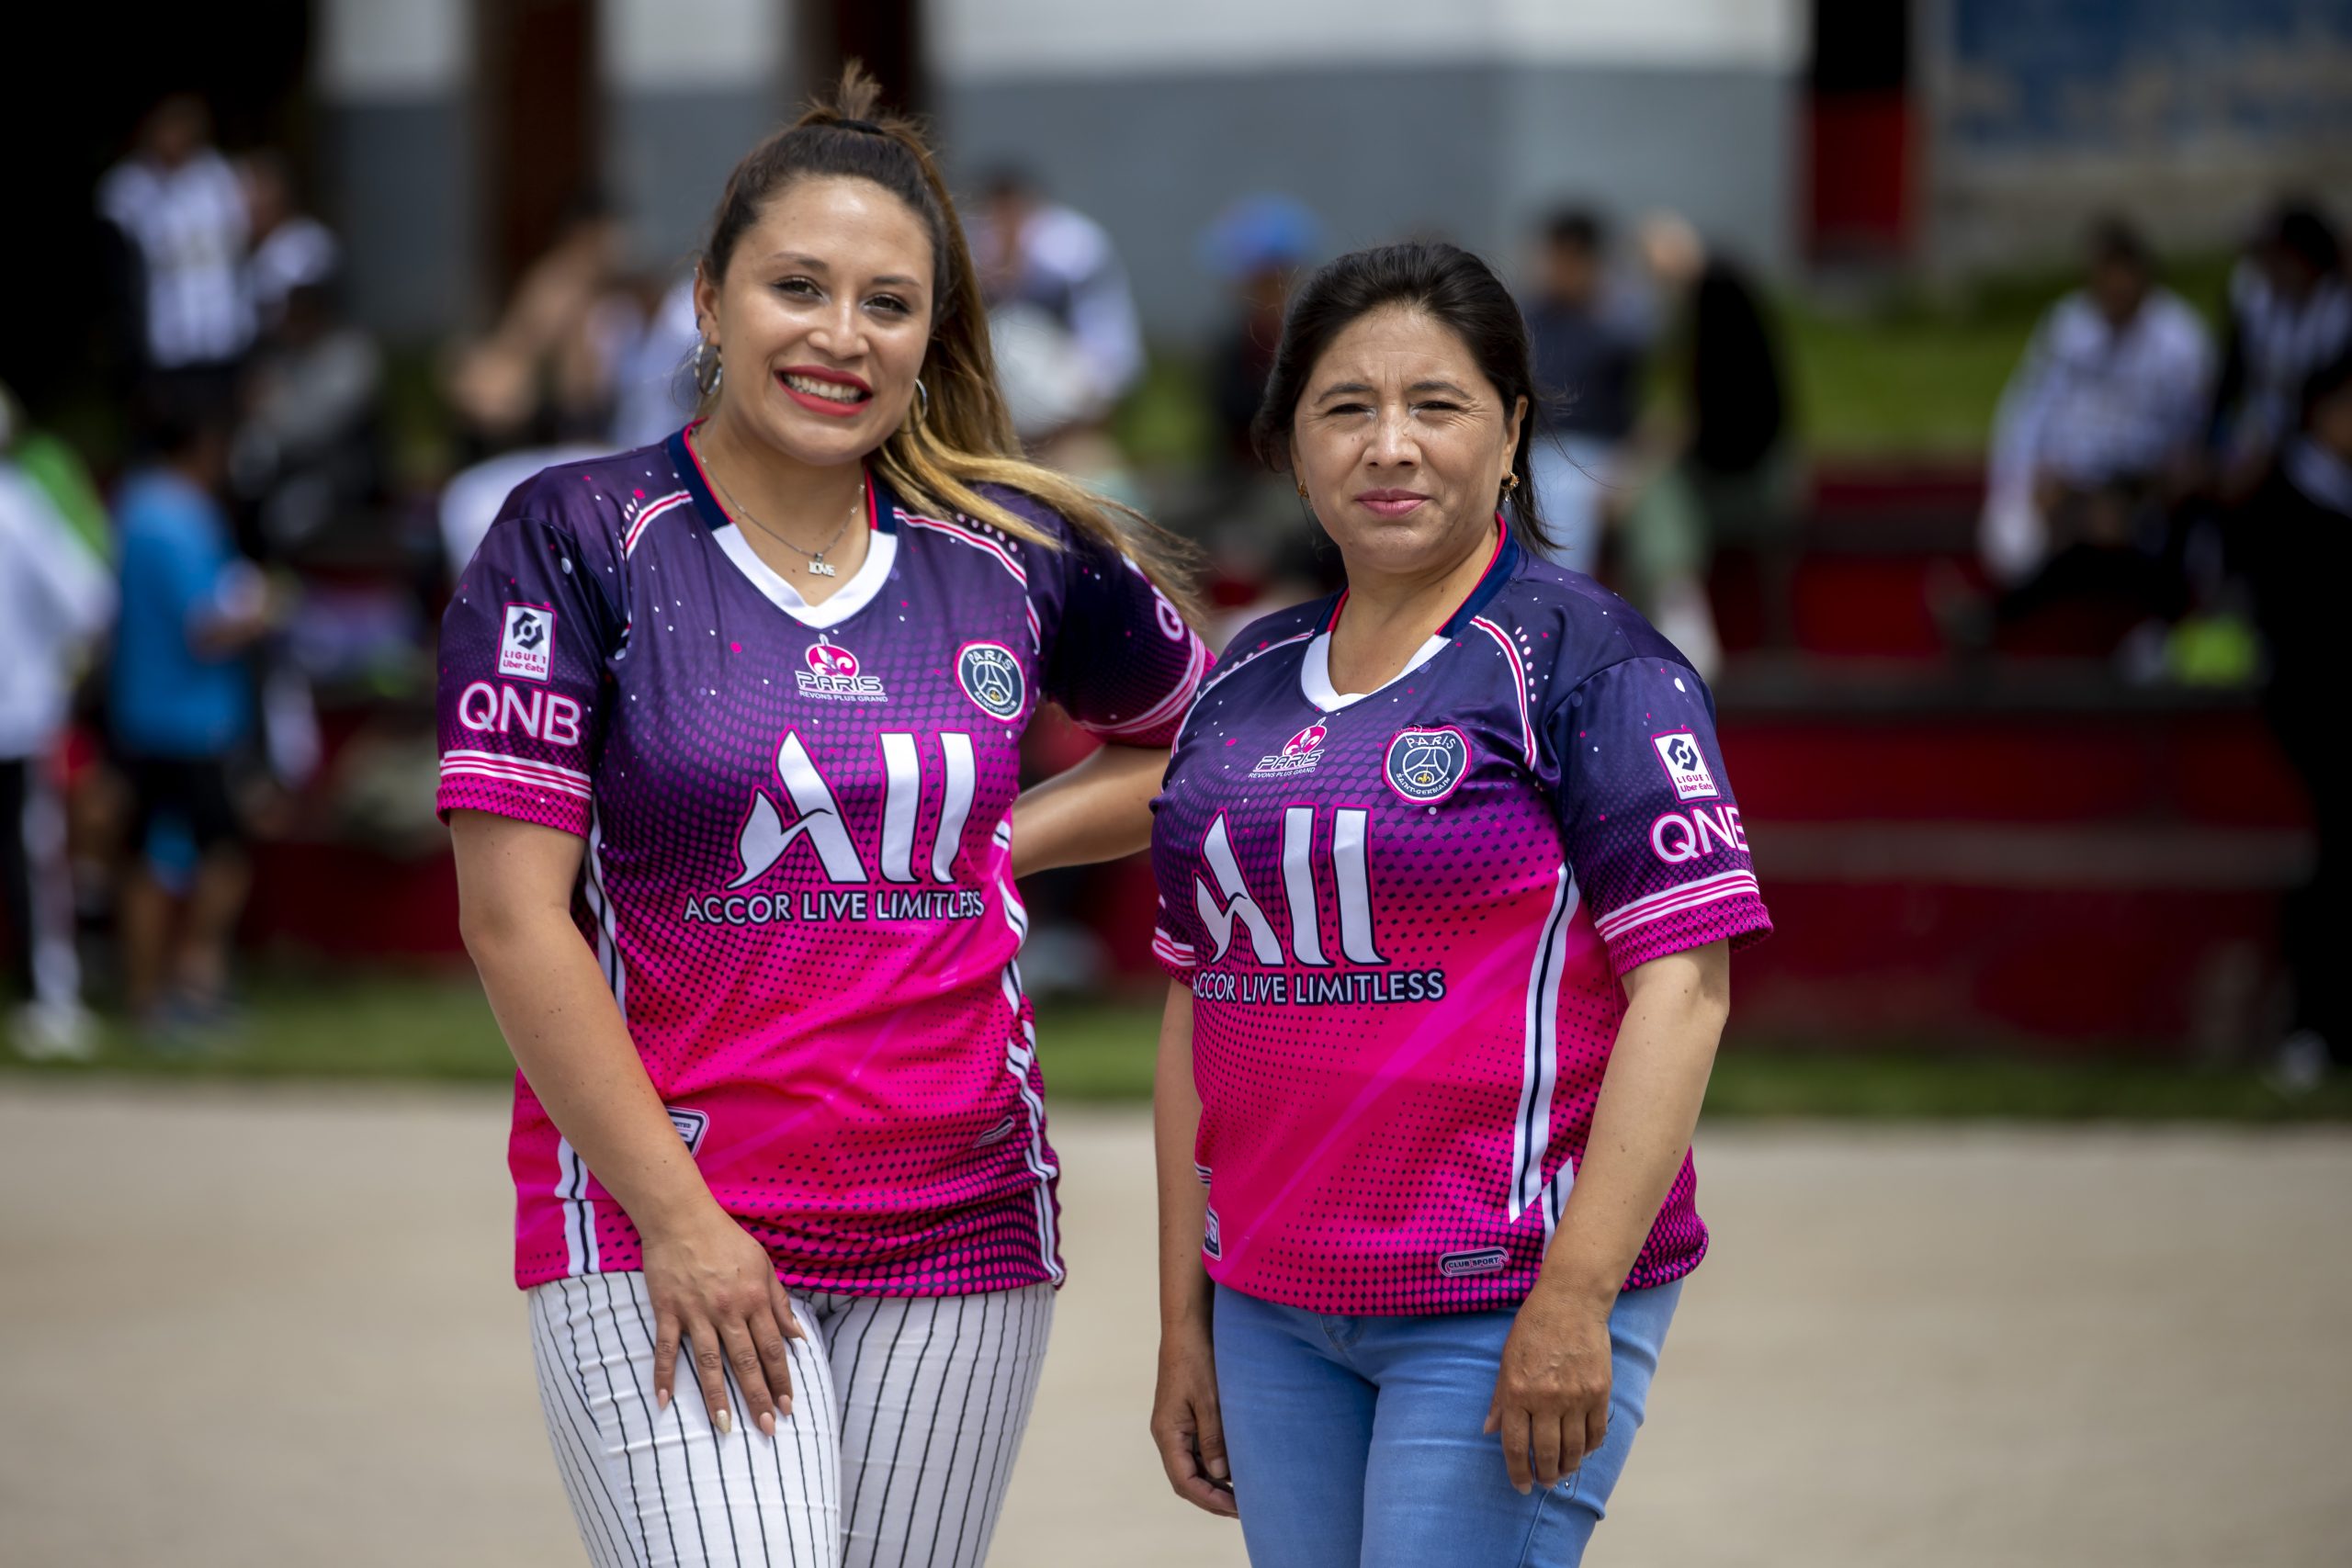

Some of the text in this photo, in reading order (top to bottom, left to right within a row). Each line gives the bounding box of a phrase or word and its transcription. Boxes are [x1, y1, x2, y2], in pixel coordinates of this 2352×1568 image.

[504, 649, 547, 664] LIGUE 1
[967, 649, 1014, 671] PARIS
[503, 660, 524, 669] Uber
[795, 671, 884, 693] PARIS
[833, 694, 856, 702] PLUS
[459, 682, 581, 746] QNB
[1405, 736, 1456, 750] PARIS
[1256, 749, 1325, 769] PARIS
[1293, 767, 1316, 775] GRAND
[1677, 773, 1703, 784] LIGUE
[1680, 783, 1713, 793] Uber Eats
[684, 891, 985, 924] ACCOR LIVE LIMITLESS
[1242, 976, 1286, 1002] LIVE
[1295, 971, 1444, 1003] LIMITLESS
[1448, 1257, 1499, 1269] CLUB SPORT
